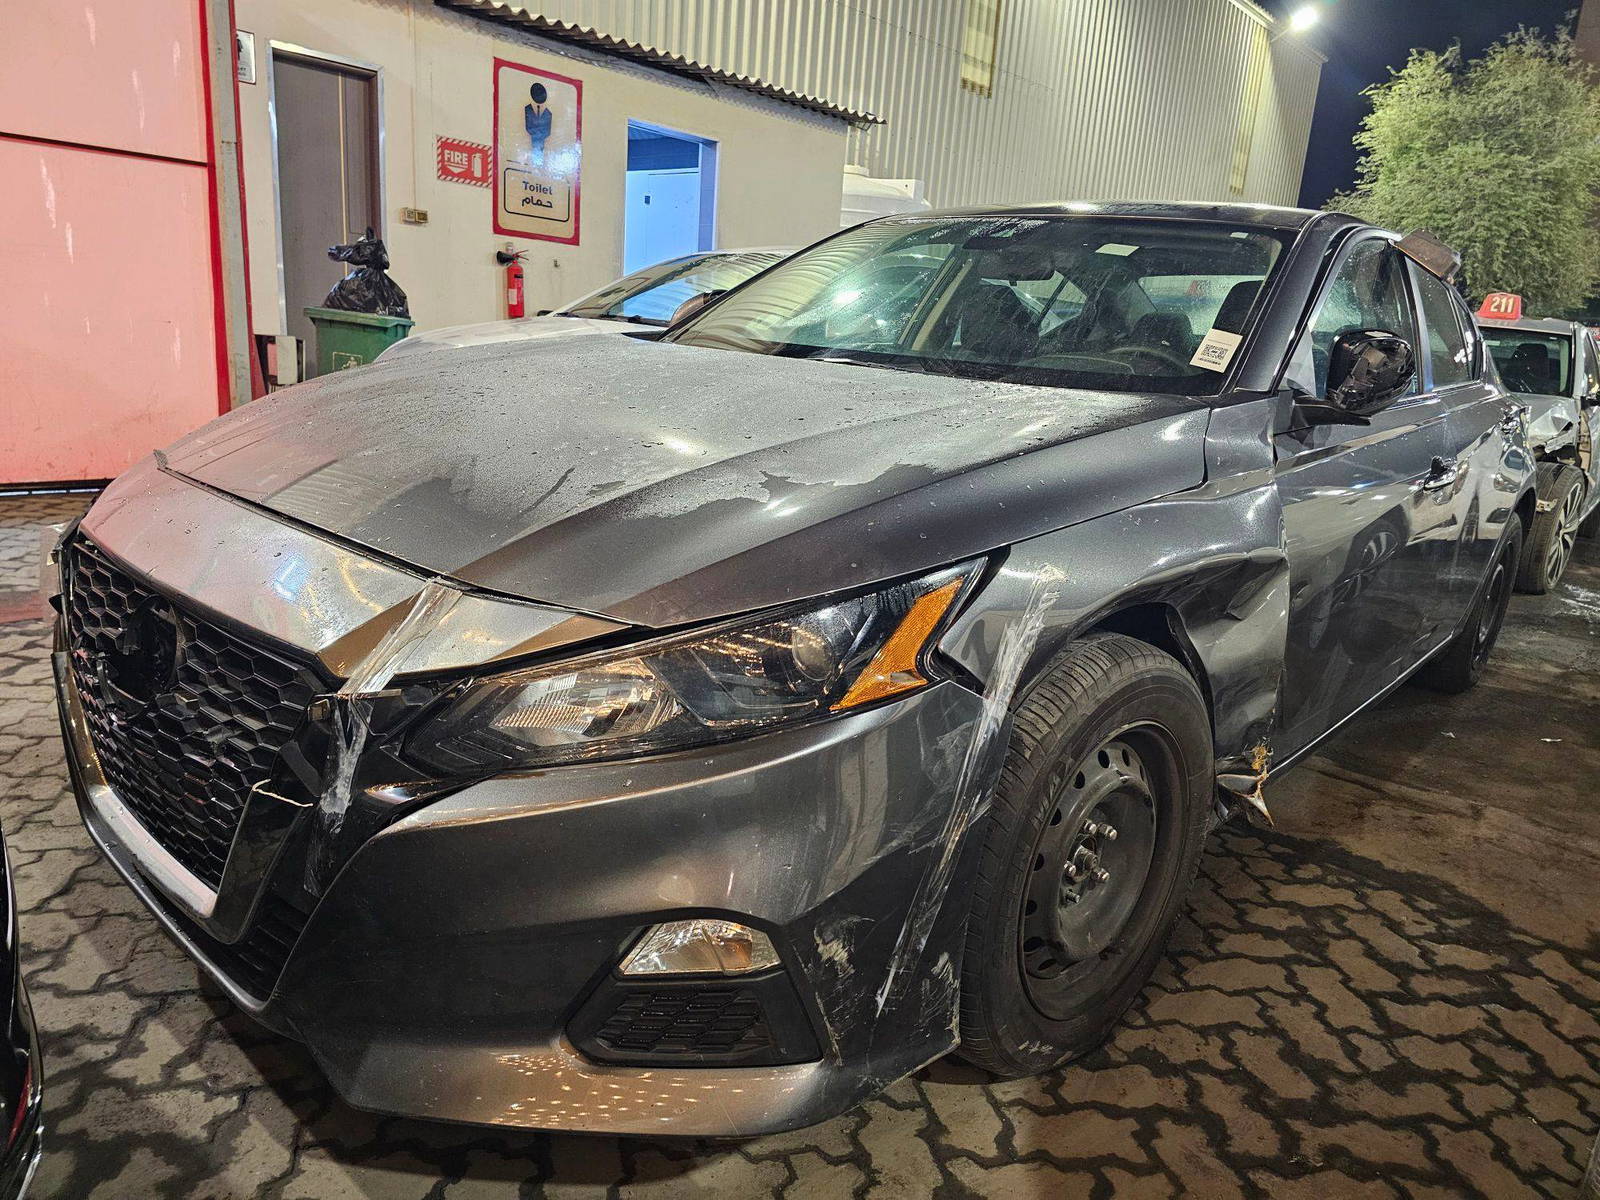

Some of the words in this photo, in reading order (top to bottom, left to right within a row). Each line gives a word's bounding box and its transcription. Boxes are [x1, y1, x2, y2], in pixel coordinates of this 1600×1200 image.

[444, 149, 469, 166] FIRE
[522, 180, 553, 195] Toilet
[521, 195, 553, 208] حمام
[1490, 296, 1514, 313] 211
